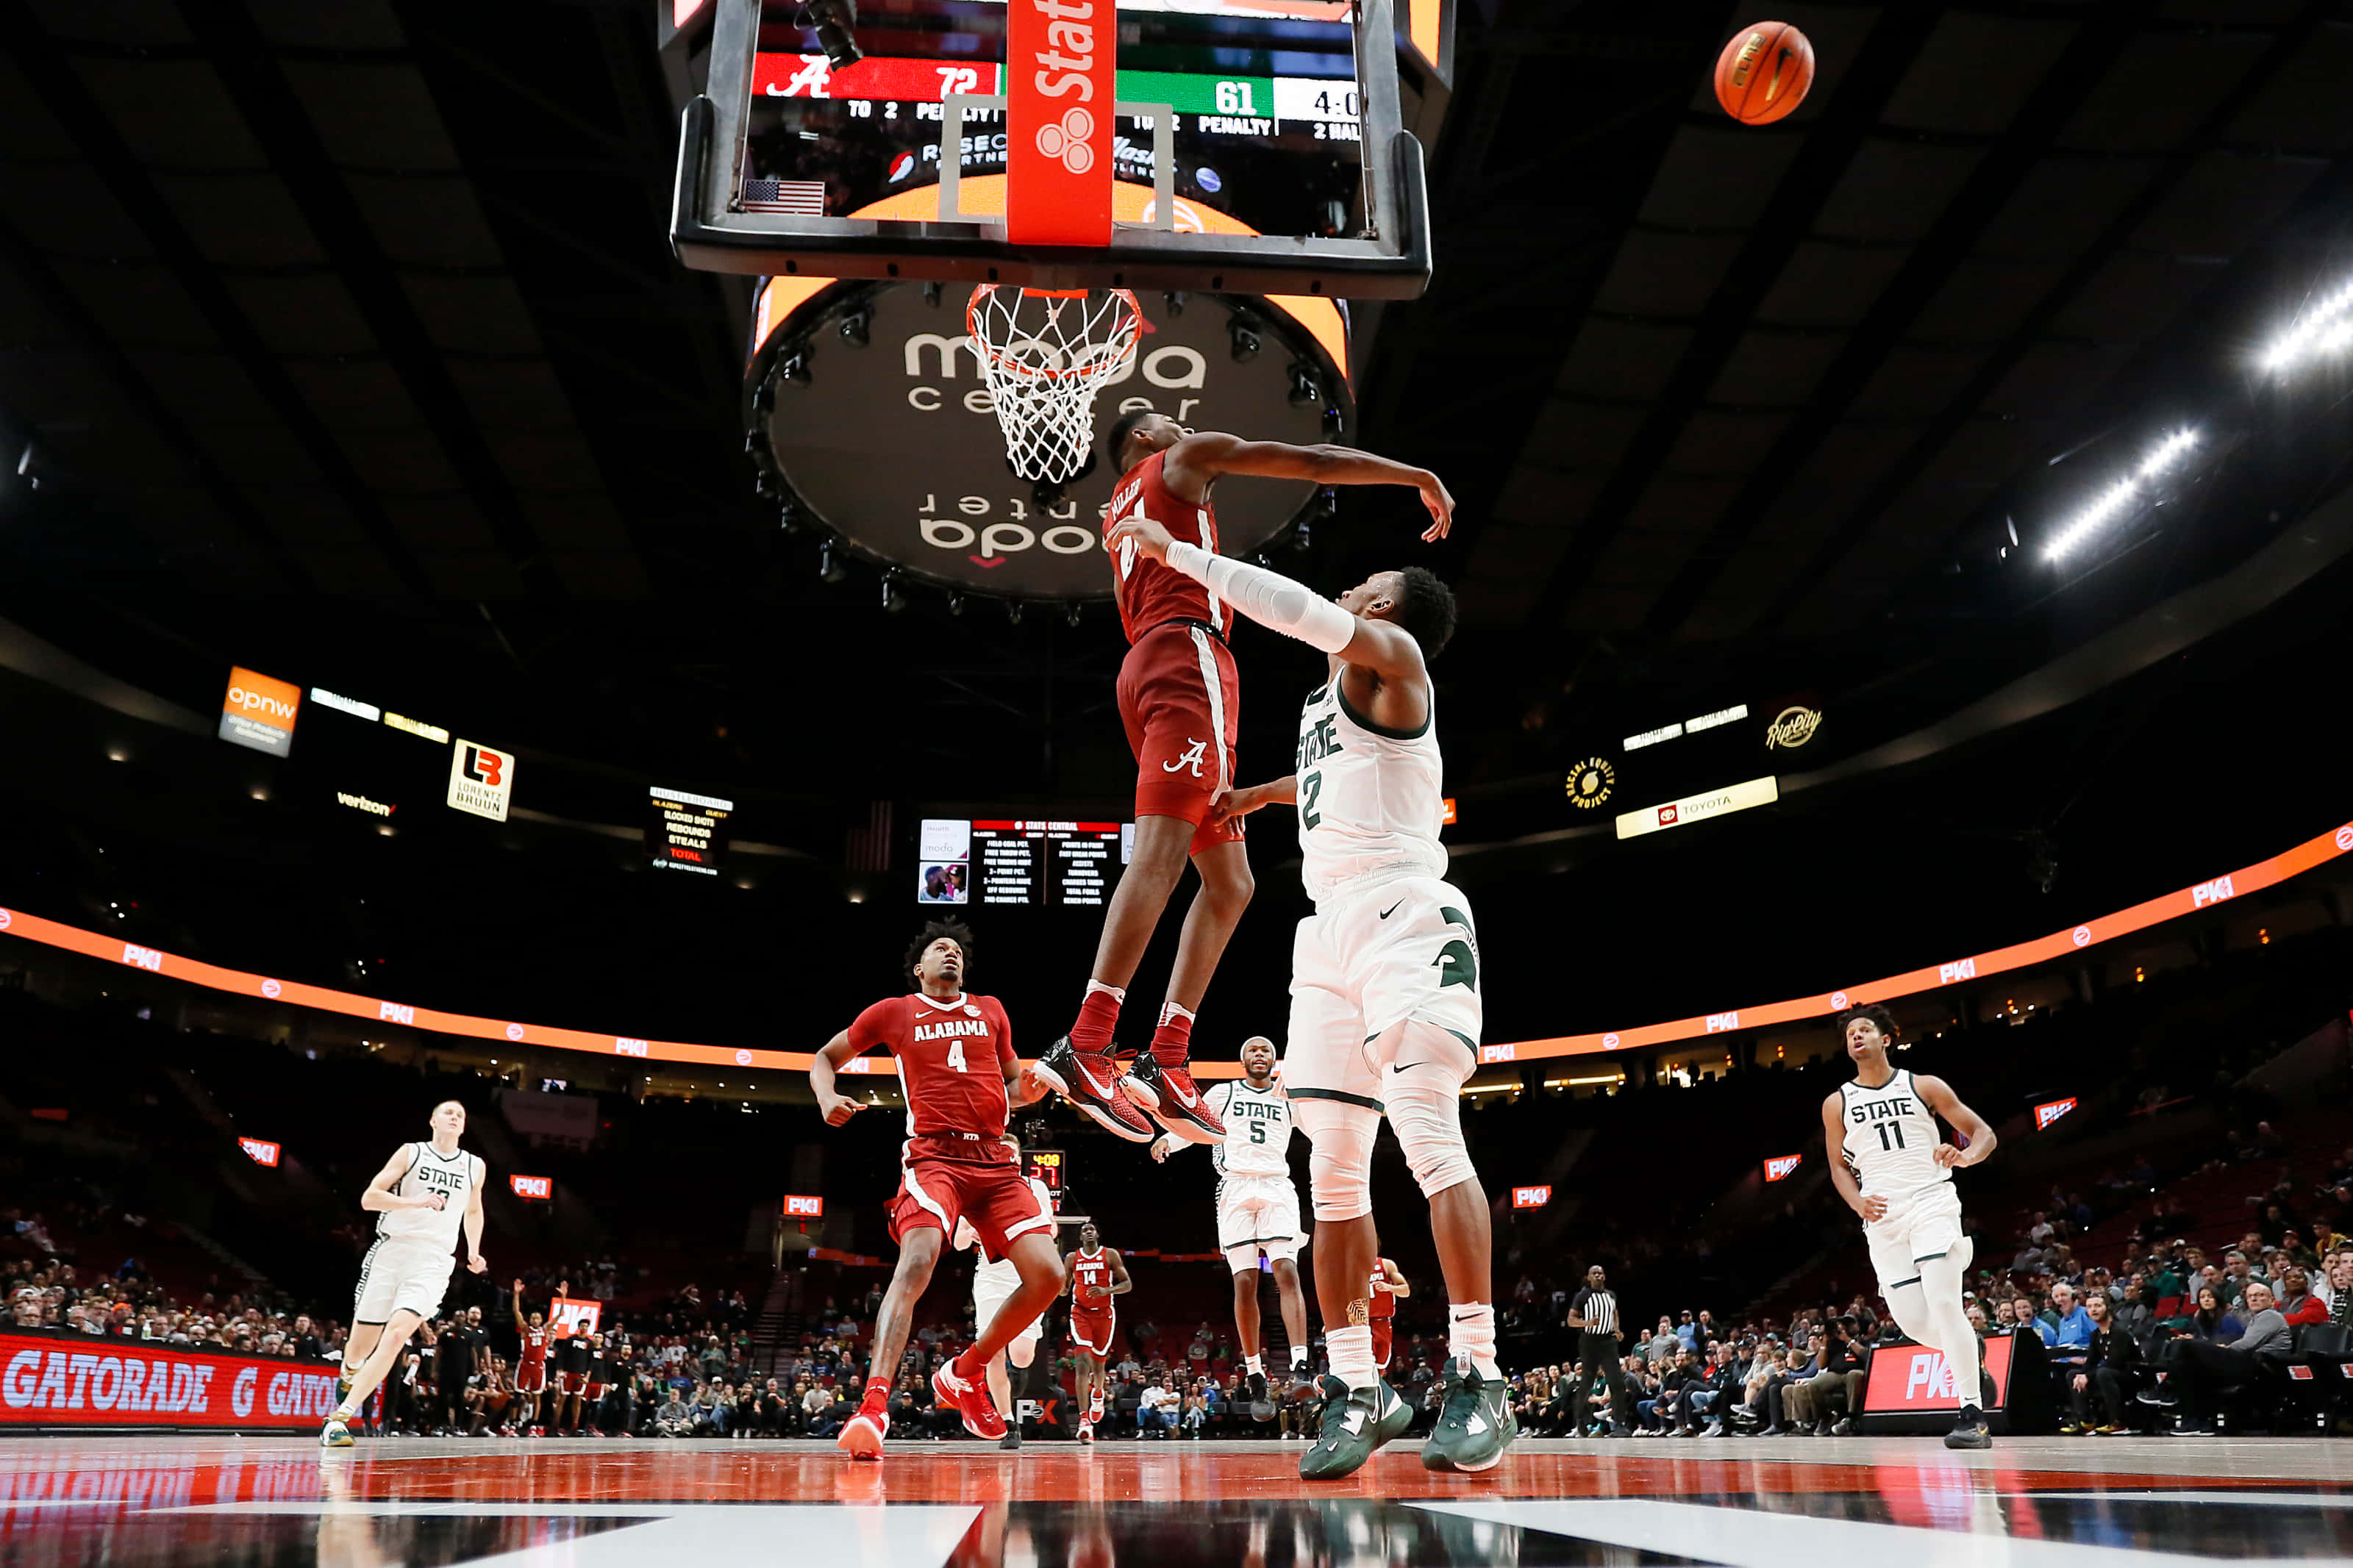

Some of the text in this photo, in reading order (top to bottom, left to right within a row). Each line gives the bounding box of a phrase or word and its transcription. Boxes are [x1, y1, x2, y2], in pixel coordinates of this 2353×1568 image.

[1215, 81, 1257, 116] 61
[848, 100, 990, 123] TO 2 PELTY
[1199, 115, 1271, 137] PENALTY
[1313, 123, 1327, 140] 2
[920, 519, 1110, 559] oda
[229, 687, 296, 719] opnw
[1296, 712, 1343, 770] STATE
[338, 792, 390, 817] verizon
[457, 792, 500, 812] BRUUN
[1303, 770, 1322, 831] 2
[1571, 787, 1611, 809] PROJECT
[1682, 795, 1731, 815] TOYOTA
[664, 810, 715, 827] BLOCKED SHOTS
[1025, 821, 1078, 831] STATS CENTRAL
[666, 822, 711, 838] REBOUNDS
[668, 834, 707, 849] STEALS
[671, 848, 702, 862] TOTAL
[2192, 876, 2235, 908] PKI
[123, 943, 163, 972] PKI
[1939, 958, 1977, 984] PKI
[379, 1000, 415, 1025] PKI
[1706, 1012, 1739, 1033] PKI
[914, 1020, 989, 1042] ALABAMA
[615, 1037, 649, 1057] PKI
[947, 1039, 968, 1073] 4
[1484, 1044, 1515, 1062] PKI
[1233, 1101, 1283, 1122] STATE
[1852, 1097, 1915, 1124] STATE
[1250, 1120, 1265, 1144] 5
[1874, 1120, 1906, 1151] 11
[1033, 1154, 1060, 1167] 4:08
[418, 1167, 465, 1190] STATE
[788, 1198, 818, 1213] PKI
[1076, 1262, 1104, 1271] ALABAMA
[1083, 1270, 1096, 1285] 14
[2, 1350, 215, 1413] GATORADE
[232, 1367, 258, 1417] G
